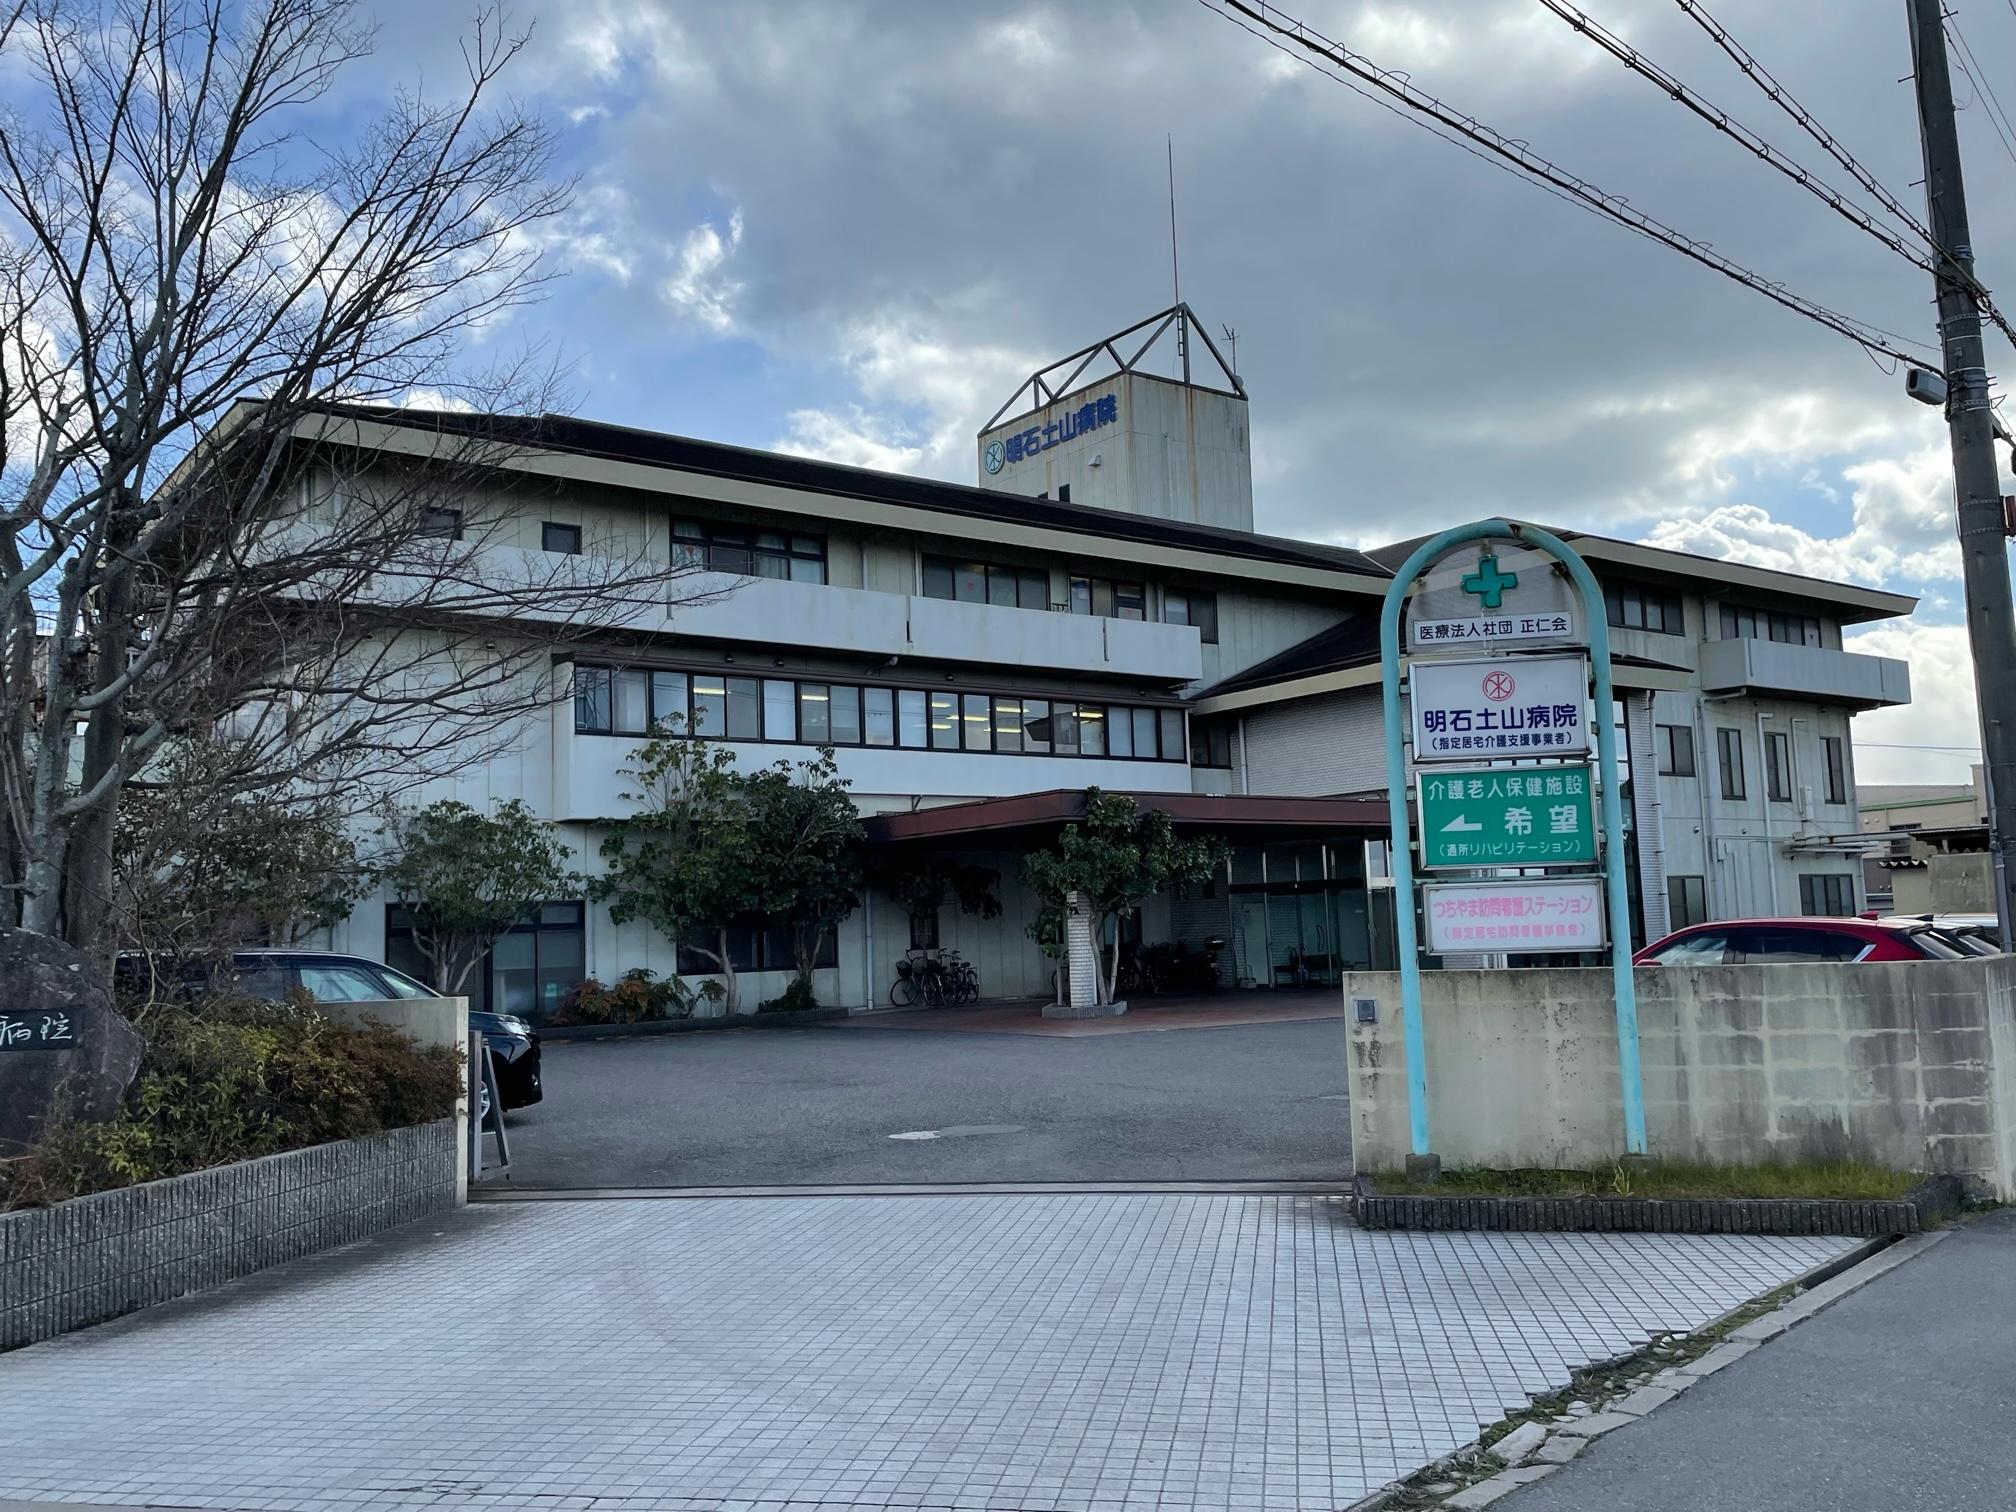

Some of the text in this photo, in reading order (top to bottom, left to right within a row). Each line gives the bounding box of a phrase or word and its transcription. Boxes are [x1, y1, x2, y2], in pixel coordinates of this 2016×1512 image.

[1006, 394, 1117, 464] 明石土山病院
[1419, 617, 1568, 640] 医療法人社団 正仁会
[1424, 703, 1578, 733] 明石土山病院
[1428, 775, 1584, 801] 介護老人保健施設
[1433, 895, 1594, 919] つちやま訪問看護ステーション
